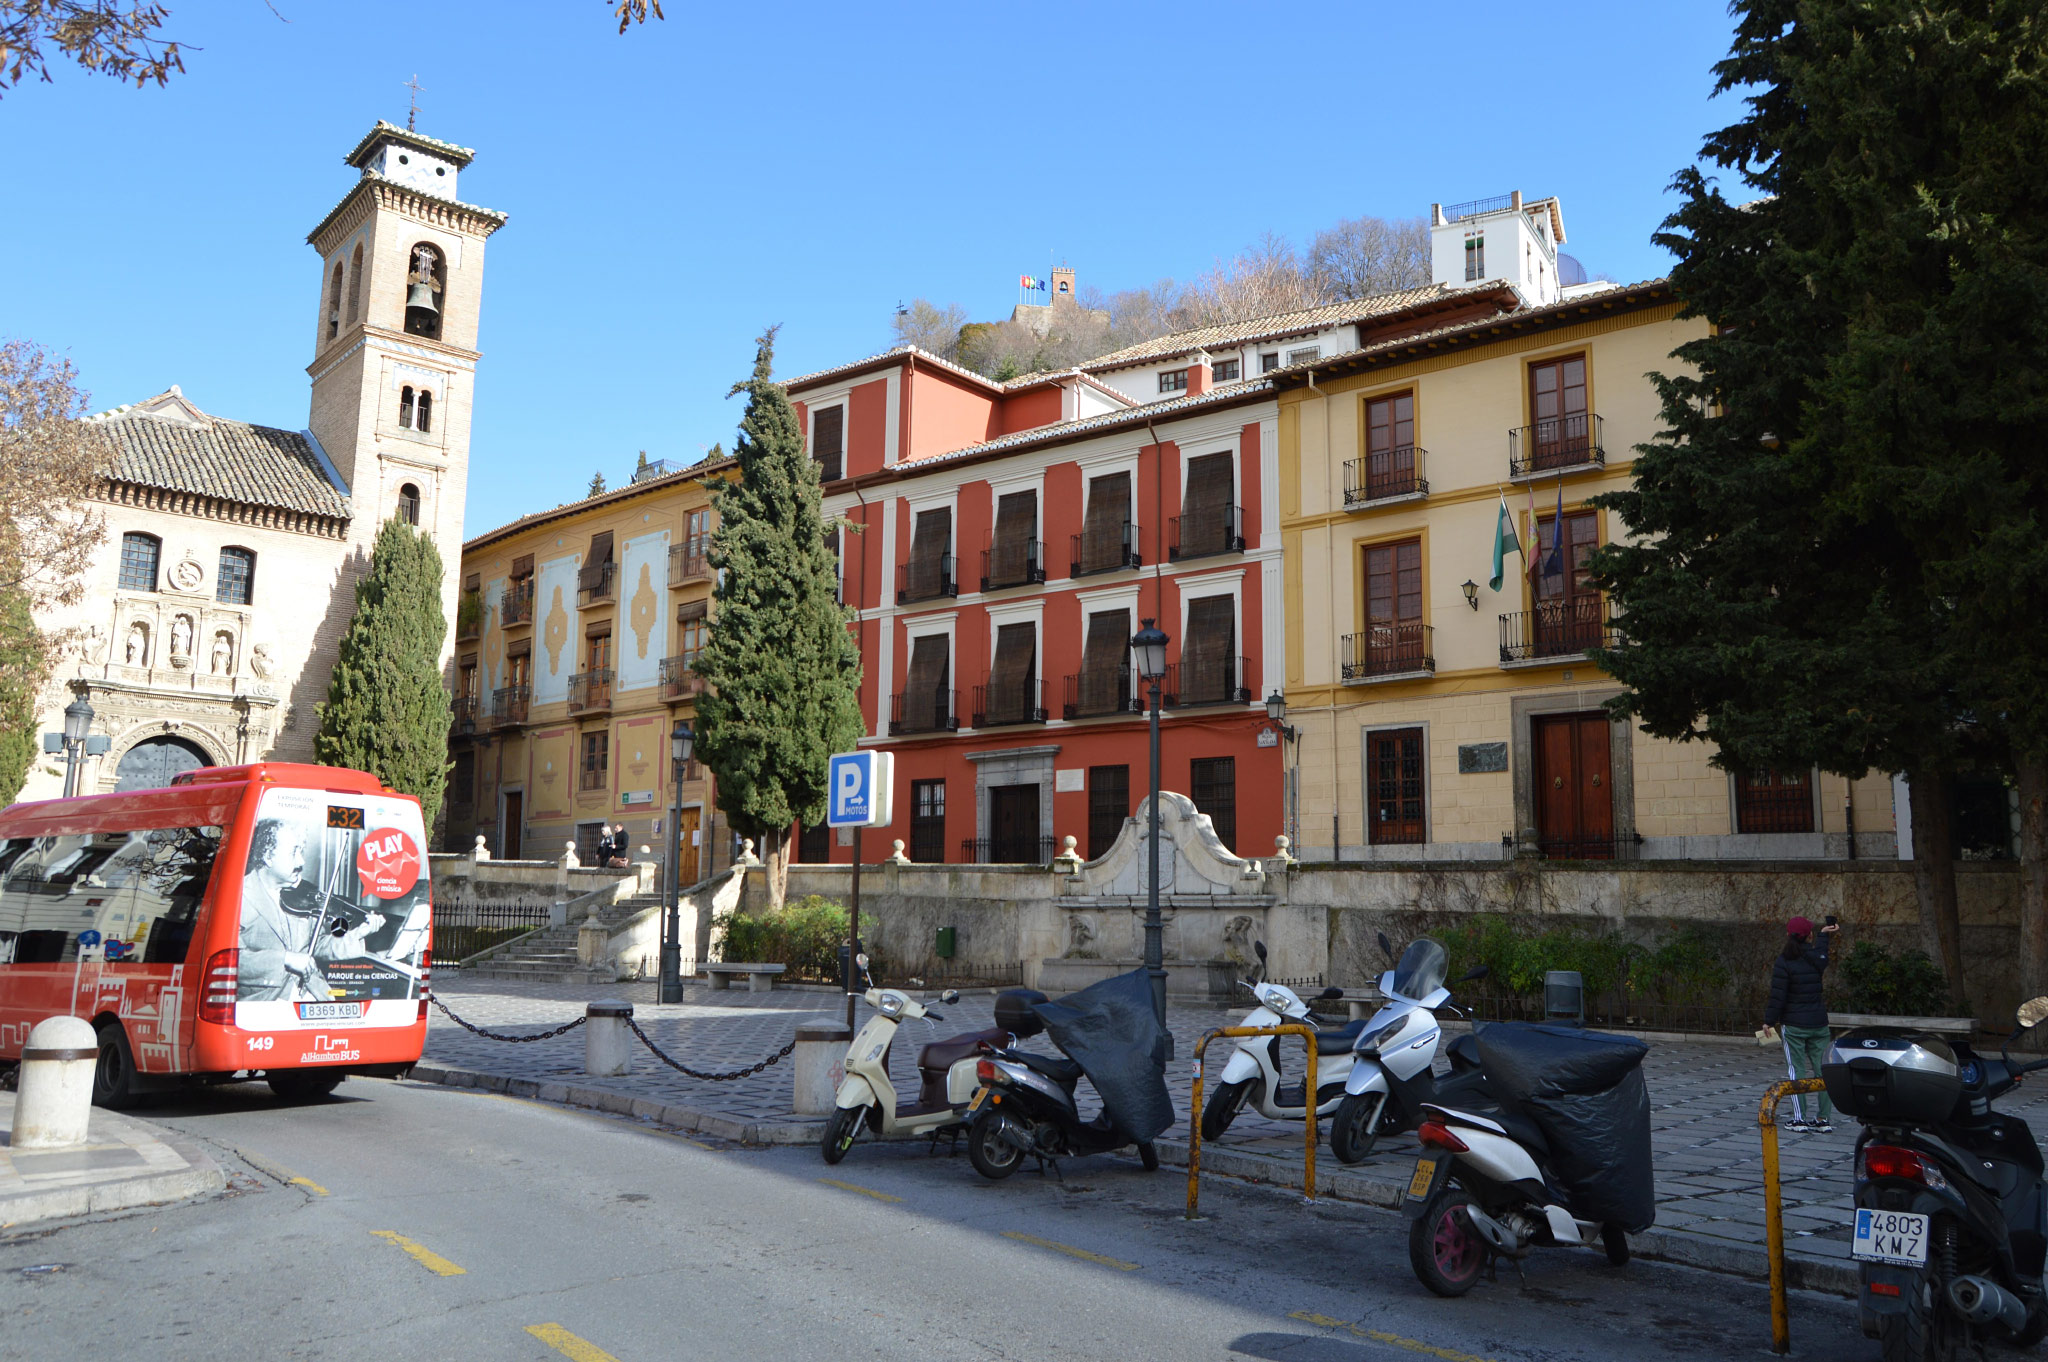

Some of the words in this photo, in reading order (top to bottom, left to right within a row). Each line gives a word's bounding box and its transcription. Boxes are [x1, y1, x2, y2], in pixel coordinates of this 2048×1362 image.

[837, 762, 862, 816] P
[328, 807, 360, 828] C32
[845, 805, 867, 815] MOTOS
[364, 833, 403, 861] PLAY
[328, 972, 354, 980] PARQUE
[371, 972, 398, 980] CIENCIAS
[308, 1005, 335, 1016] 8369
[338, 1004, 358, 1015] KBD
[247, 1036, 274, 1051] 149
[1873, 1214, 1923, 1236] 4803
[1875, 1234, 1919, 1257] KMZ
